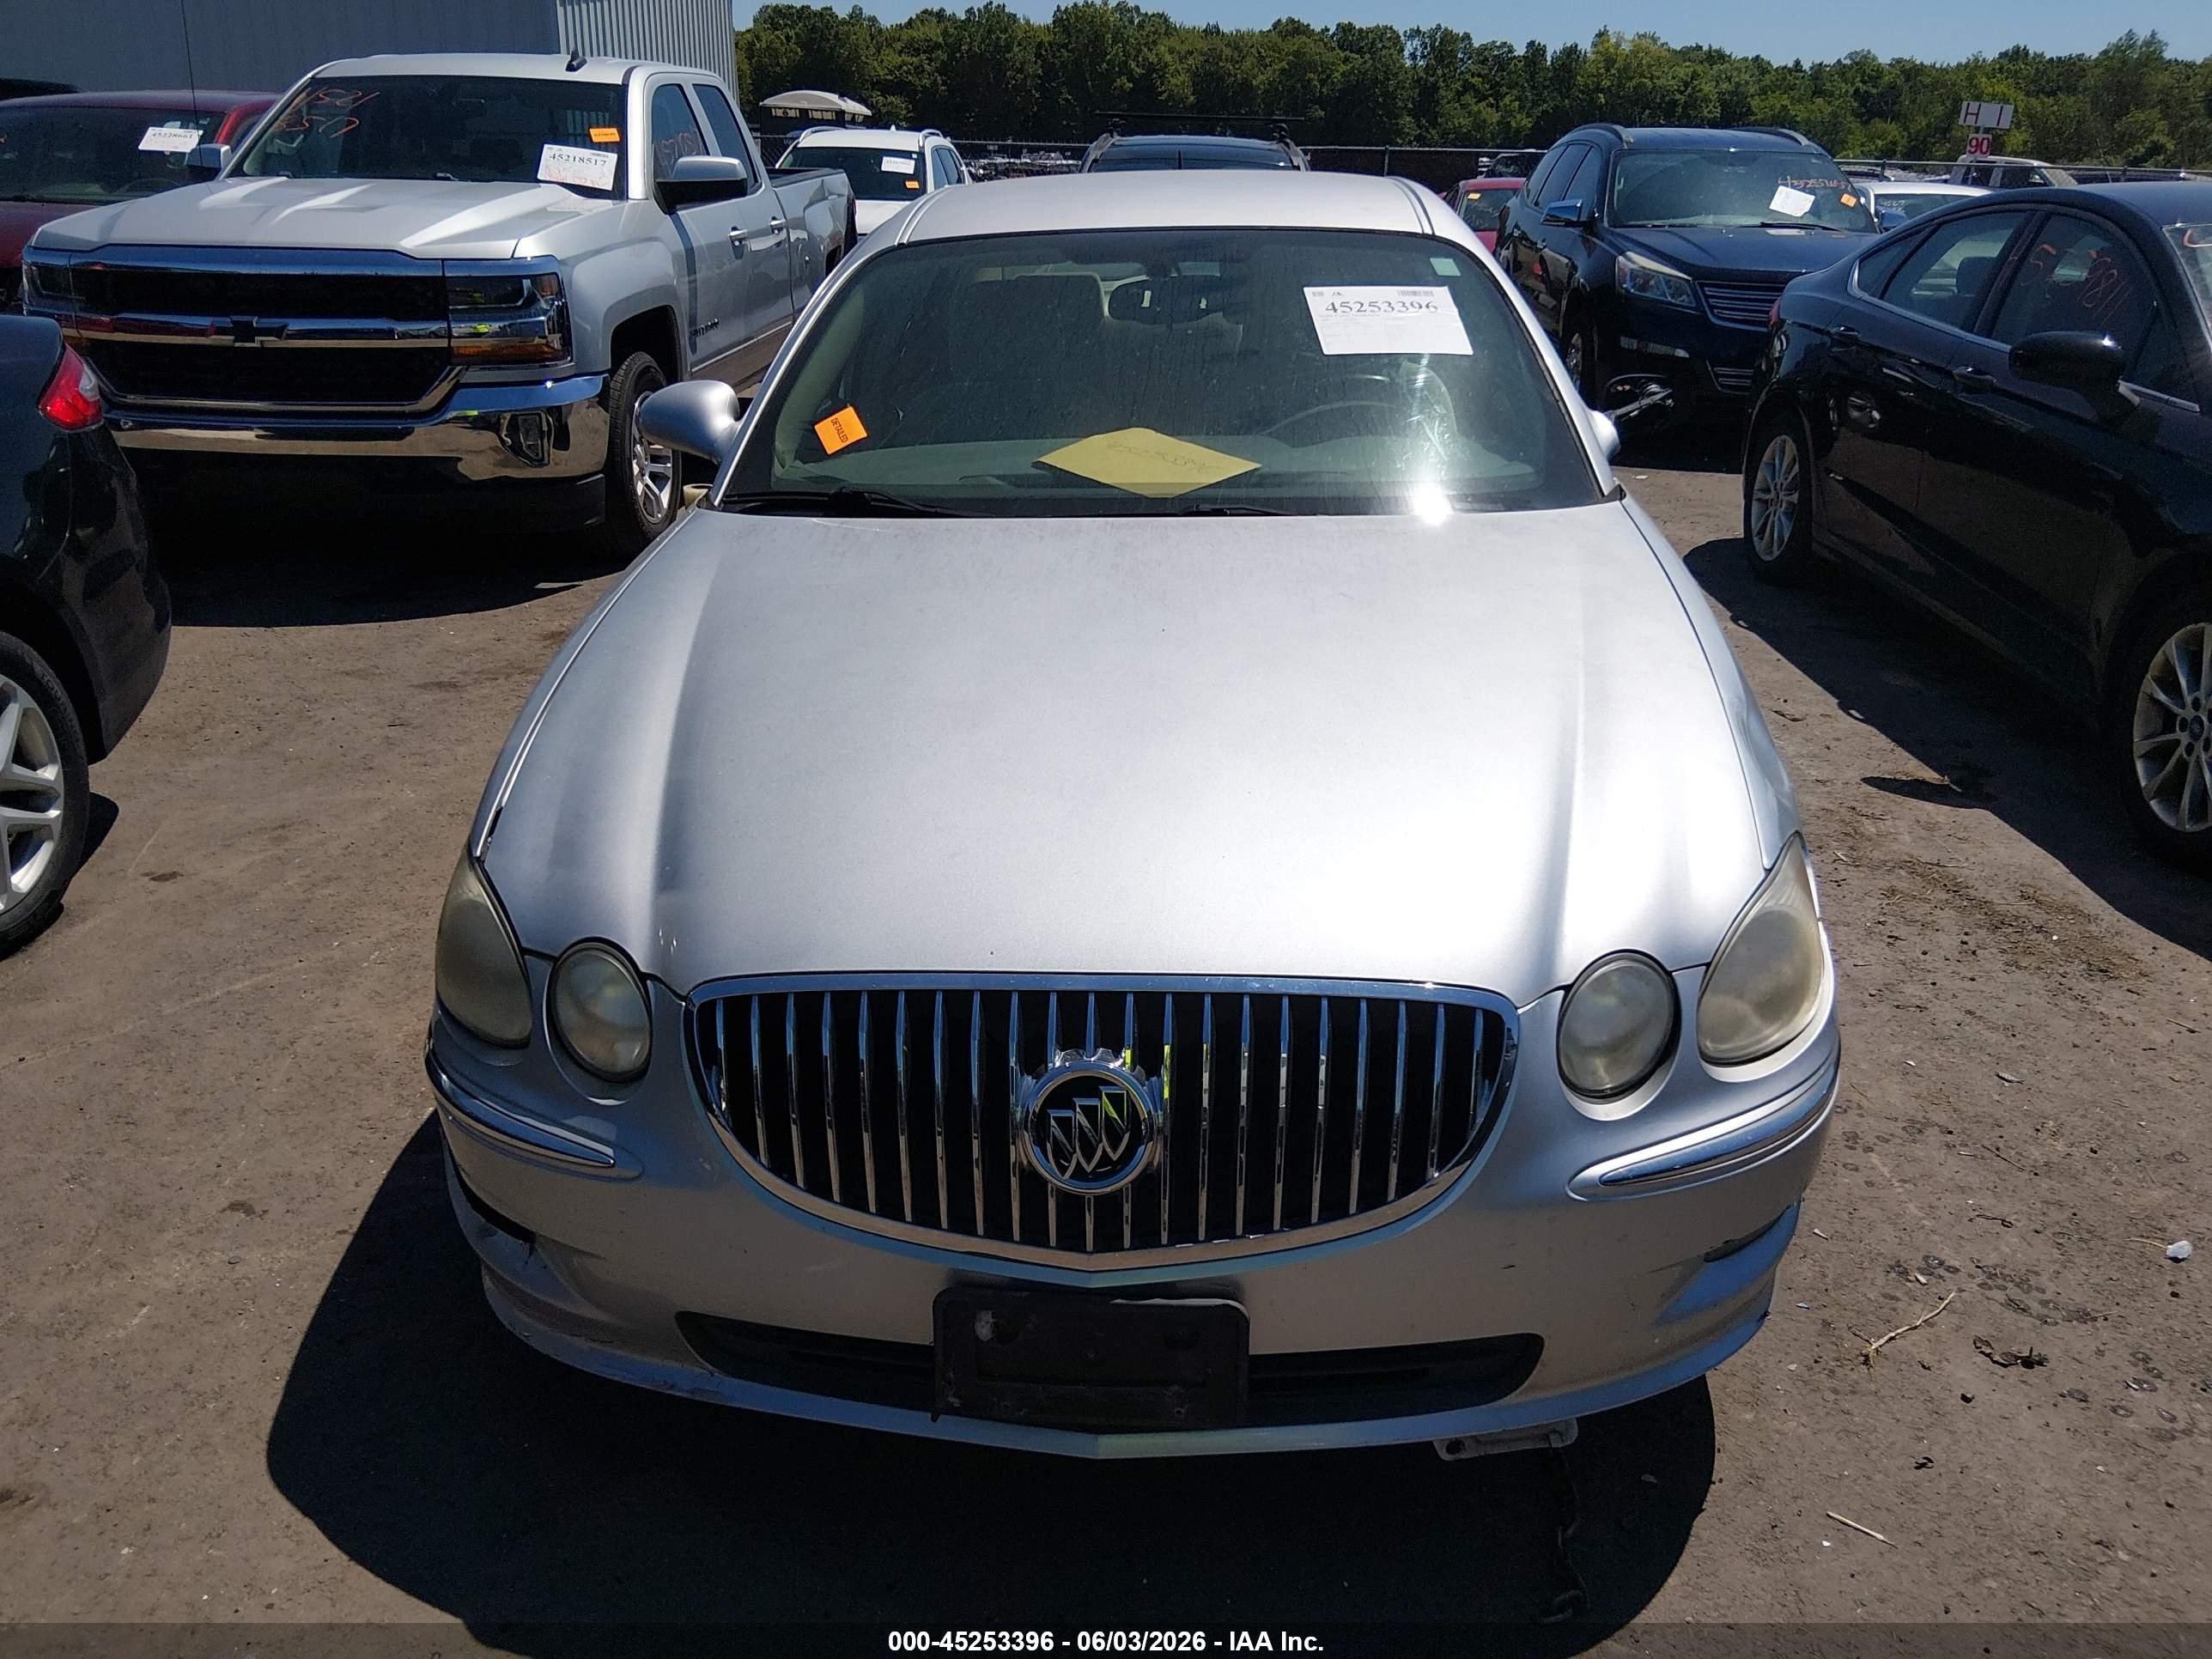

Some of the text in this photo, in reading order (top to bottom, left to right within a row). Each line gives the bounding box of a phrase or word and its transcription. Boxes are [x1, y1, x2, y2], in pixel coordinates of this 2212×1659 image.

[1968, 137, 1990, 155] 90
[549, 153, 607, 167] 45218517
[1325, 301, 1438, 313] 45253396
[830, 417, 849, 443] DETAILED
